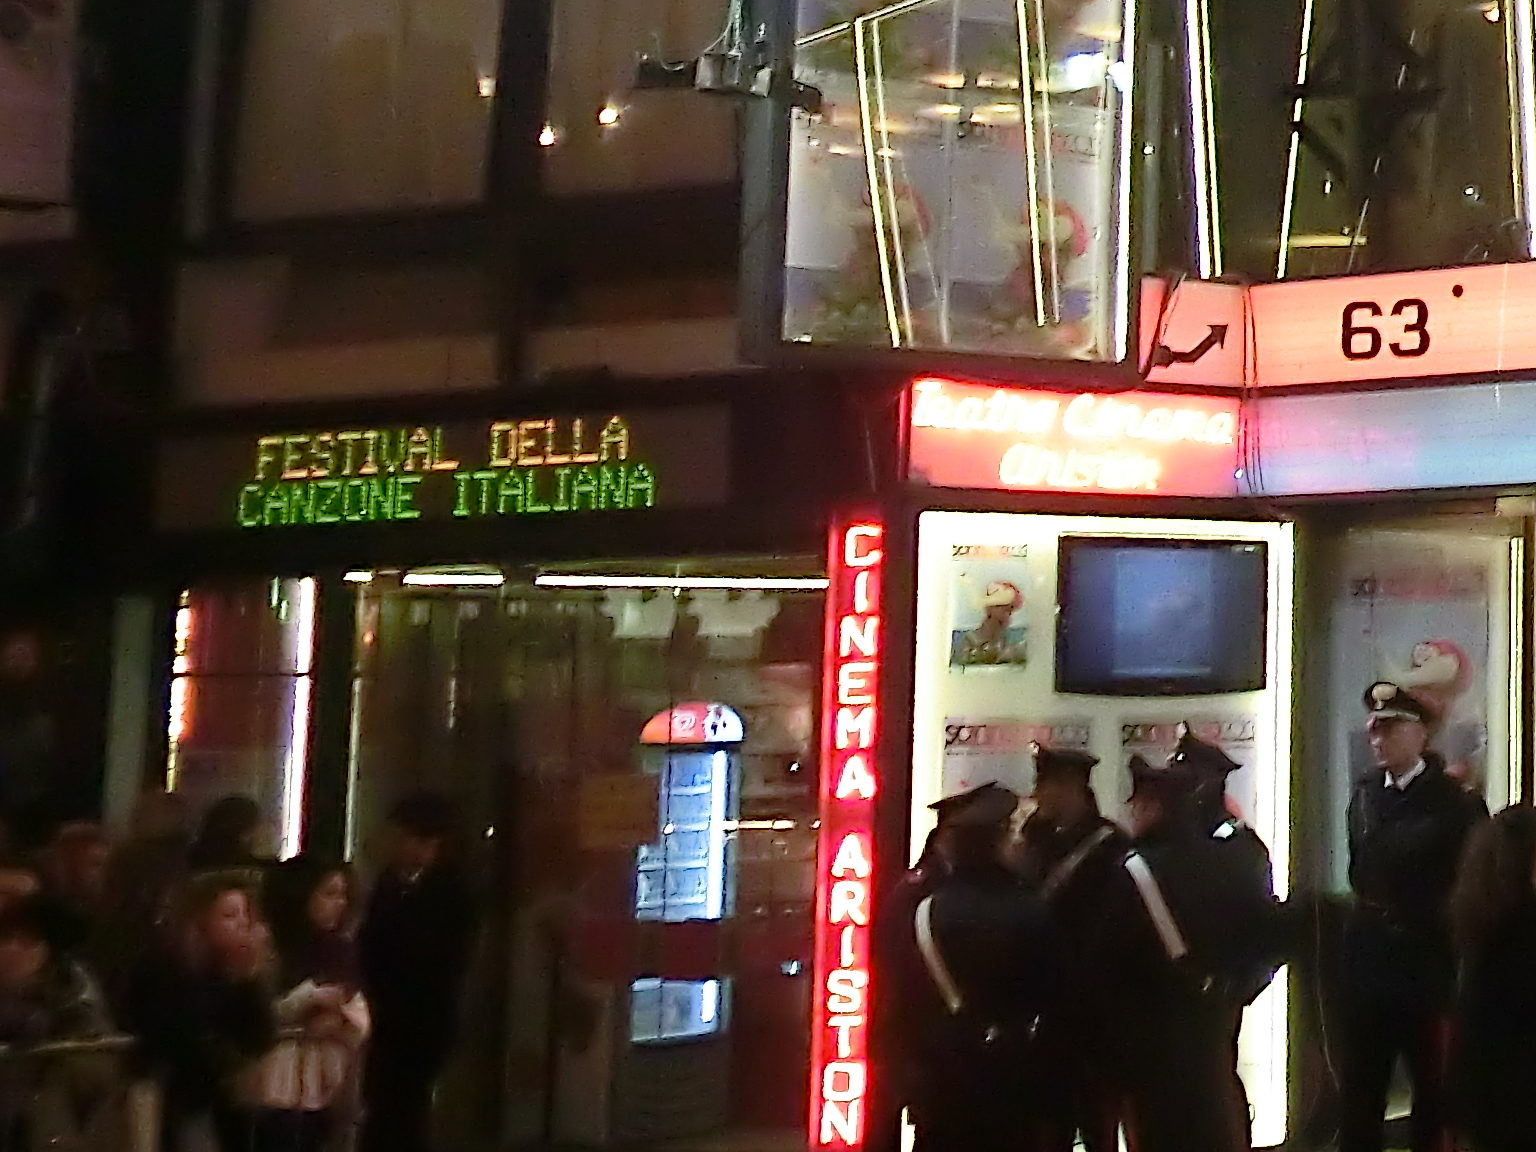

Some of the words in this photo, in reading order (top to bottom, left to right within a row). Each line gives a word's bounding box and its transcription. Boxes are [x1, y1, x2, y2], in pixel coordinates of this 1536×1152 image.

[237, 474, 424, 528] CANZONE
[451, 463, 657, 518] ITALIANA
[254, 426, 460, 481] FESTIVAL
[489, 415, 631, 468] DELLA
[831, 524, 884, 800] CINEMA
[818, 833, 871, 1146] ARISTON
